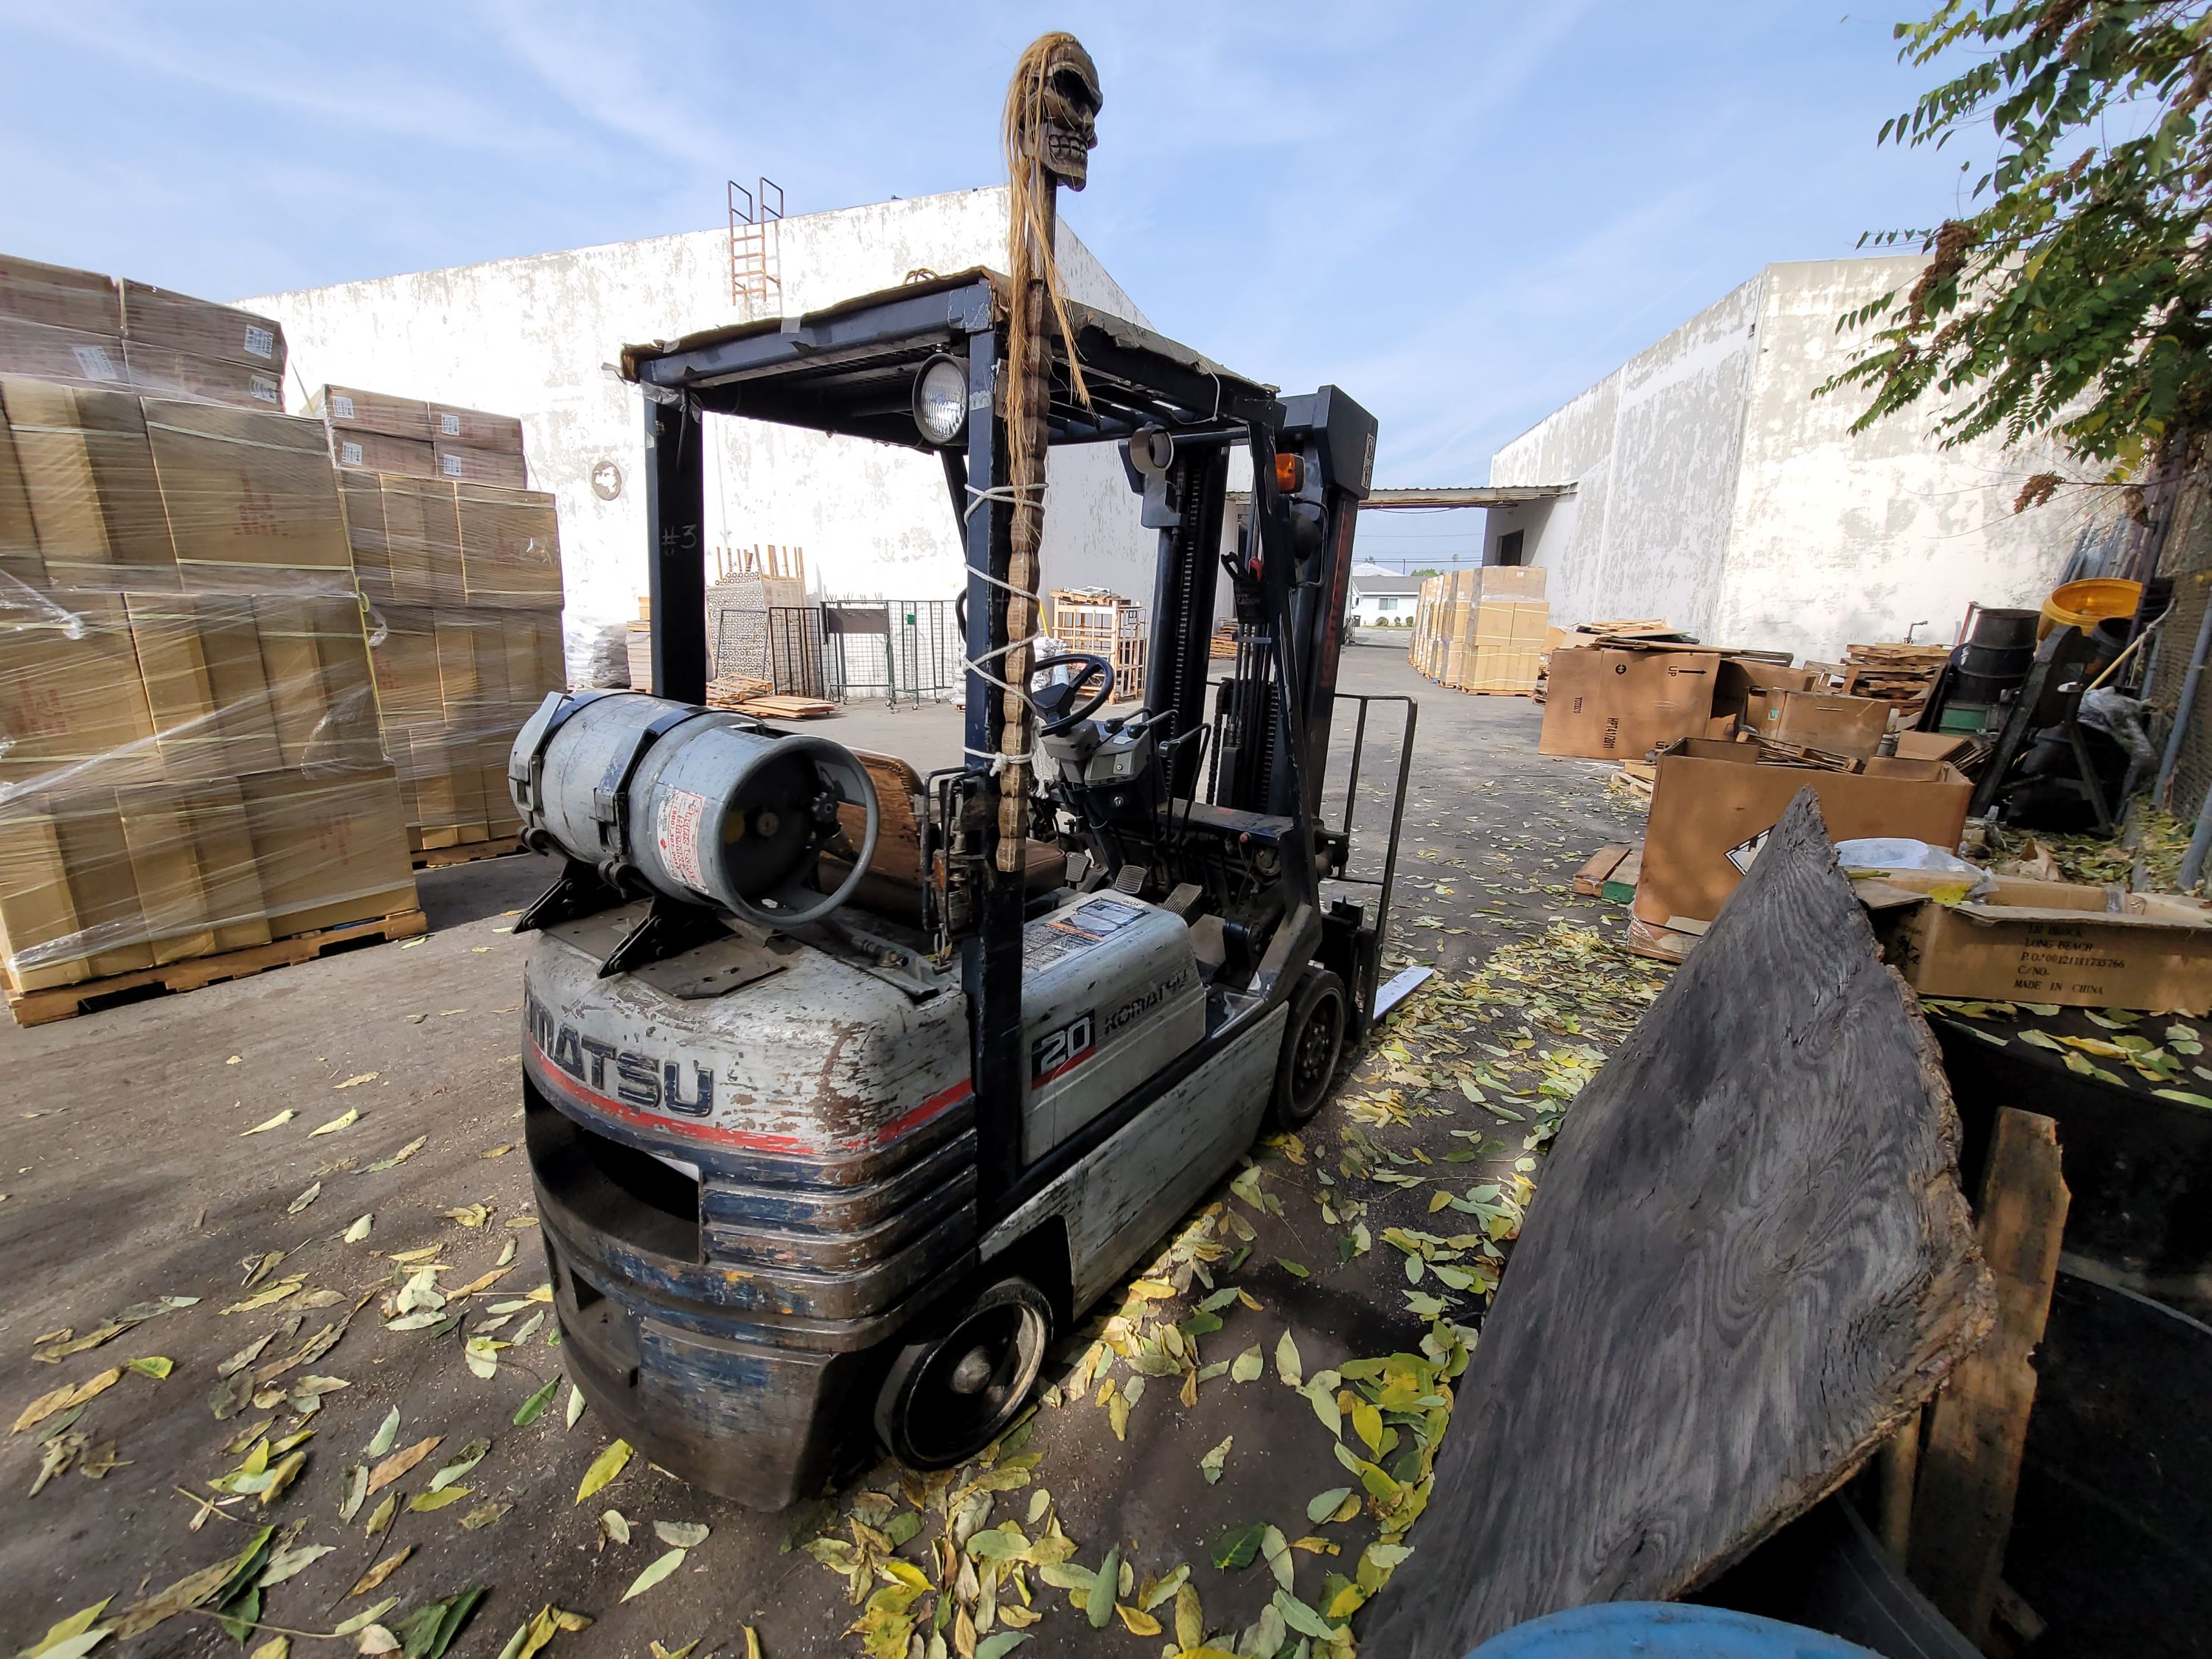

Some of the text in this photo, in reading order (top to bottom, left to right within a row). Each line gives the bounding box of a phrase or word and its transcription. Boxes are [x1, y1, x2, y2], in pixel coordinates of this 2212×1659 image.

[1668, 666, 1678, 677] UP
[2025, 938, 2093, 952] LONG BEACH
[2014, 979, 2103, 995] MADE IN CHINA
[1040, 1016, 1091, 1075] 20
